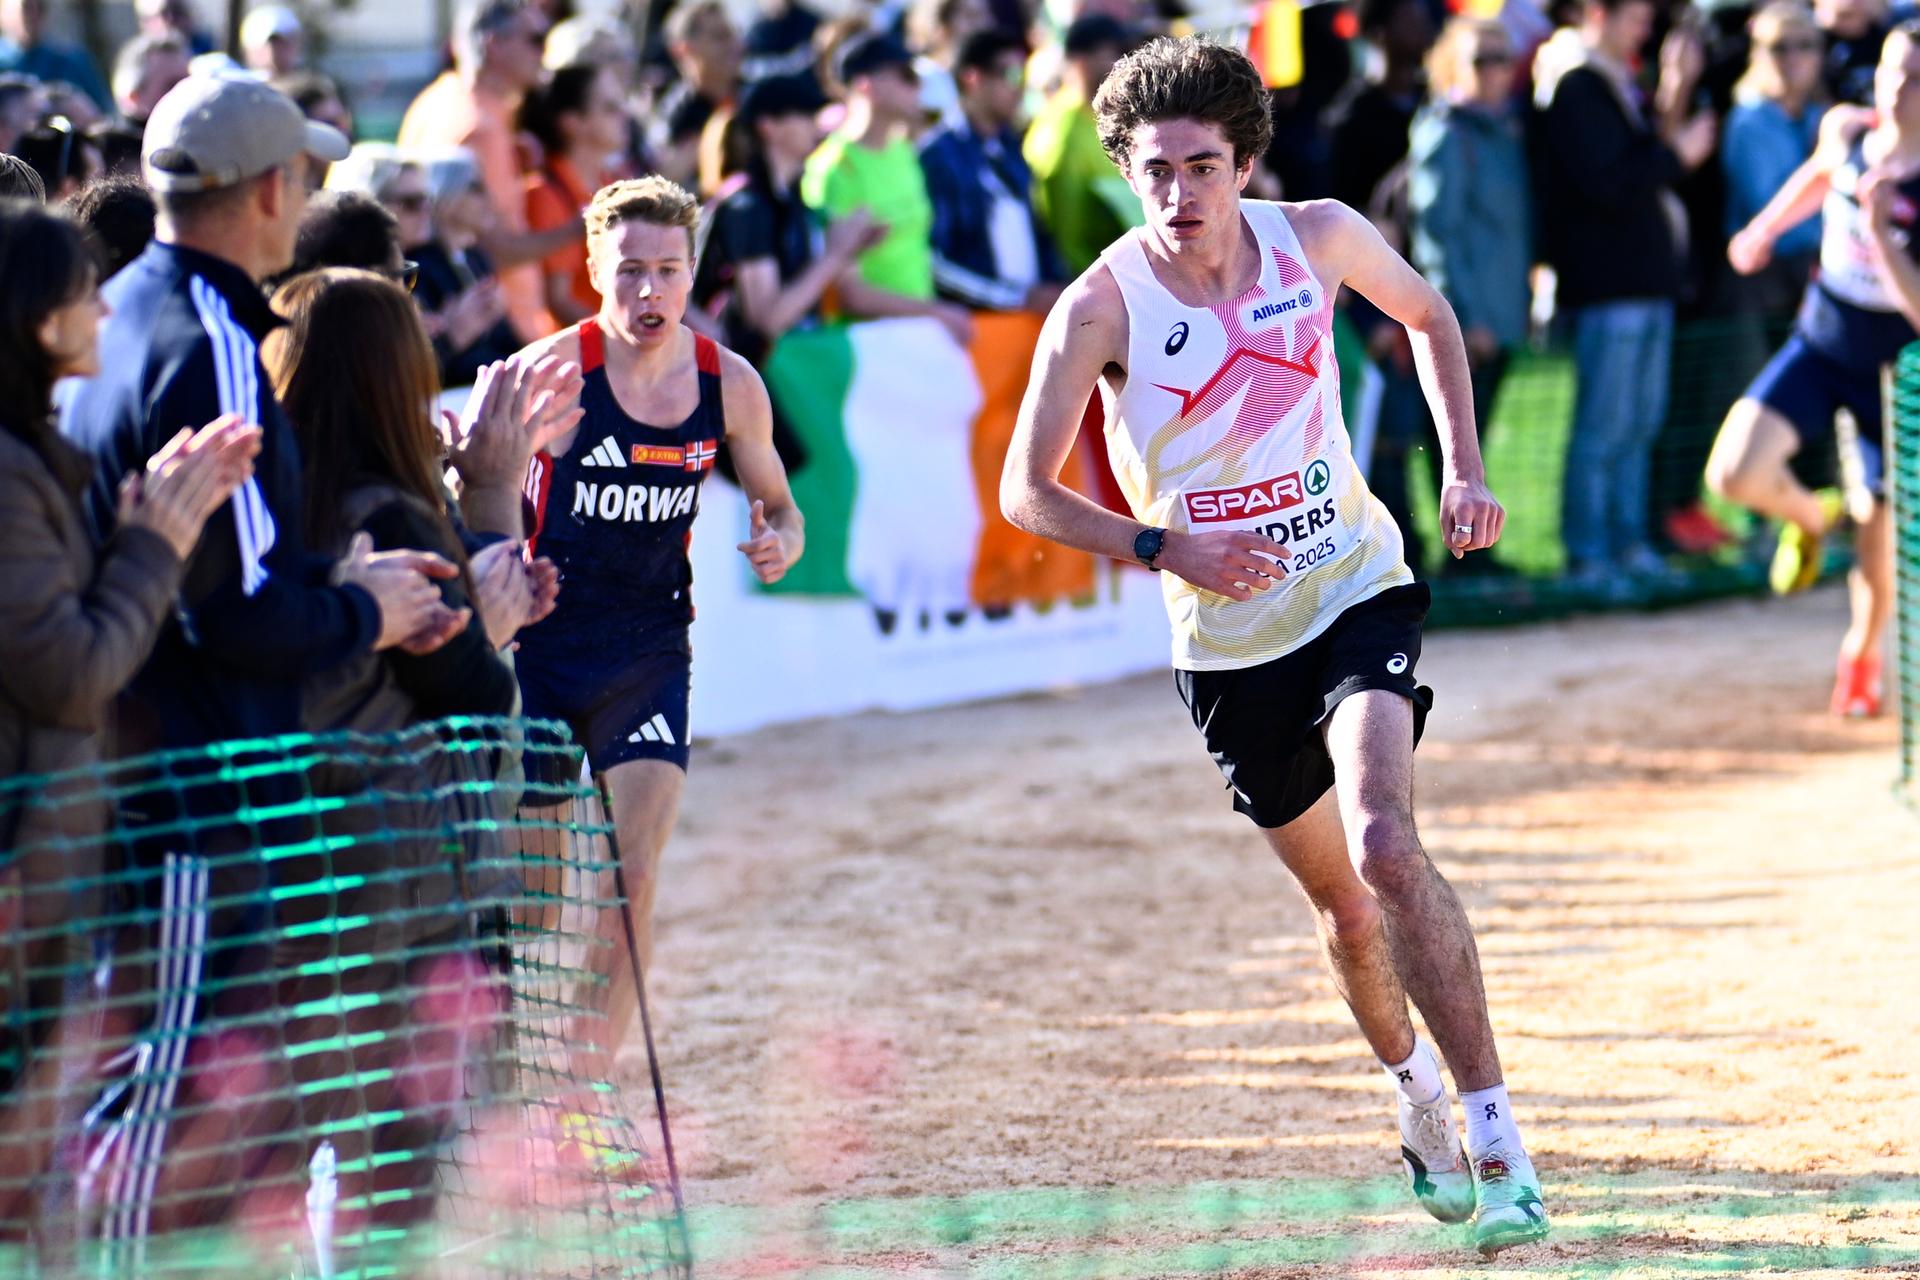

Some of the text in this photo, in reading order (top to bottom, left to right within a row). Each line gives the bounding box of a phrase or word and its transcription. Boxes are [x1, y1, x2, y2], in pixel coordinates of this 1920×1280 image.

[1252, 299, 1297, 322] Allianz
[574, 481, 702, 522] NORWA
[1191, 476, 1300, 518] SPAR
[1255, 498, 1335, 545] DERS
[1294, 536, 1336, 571] 2025
